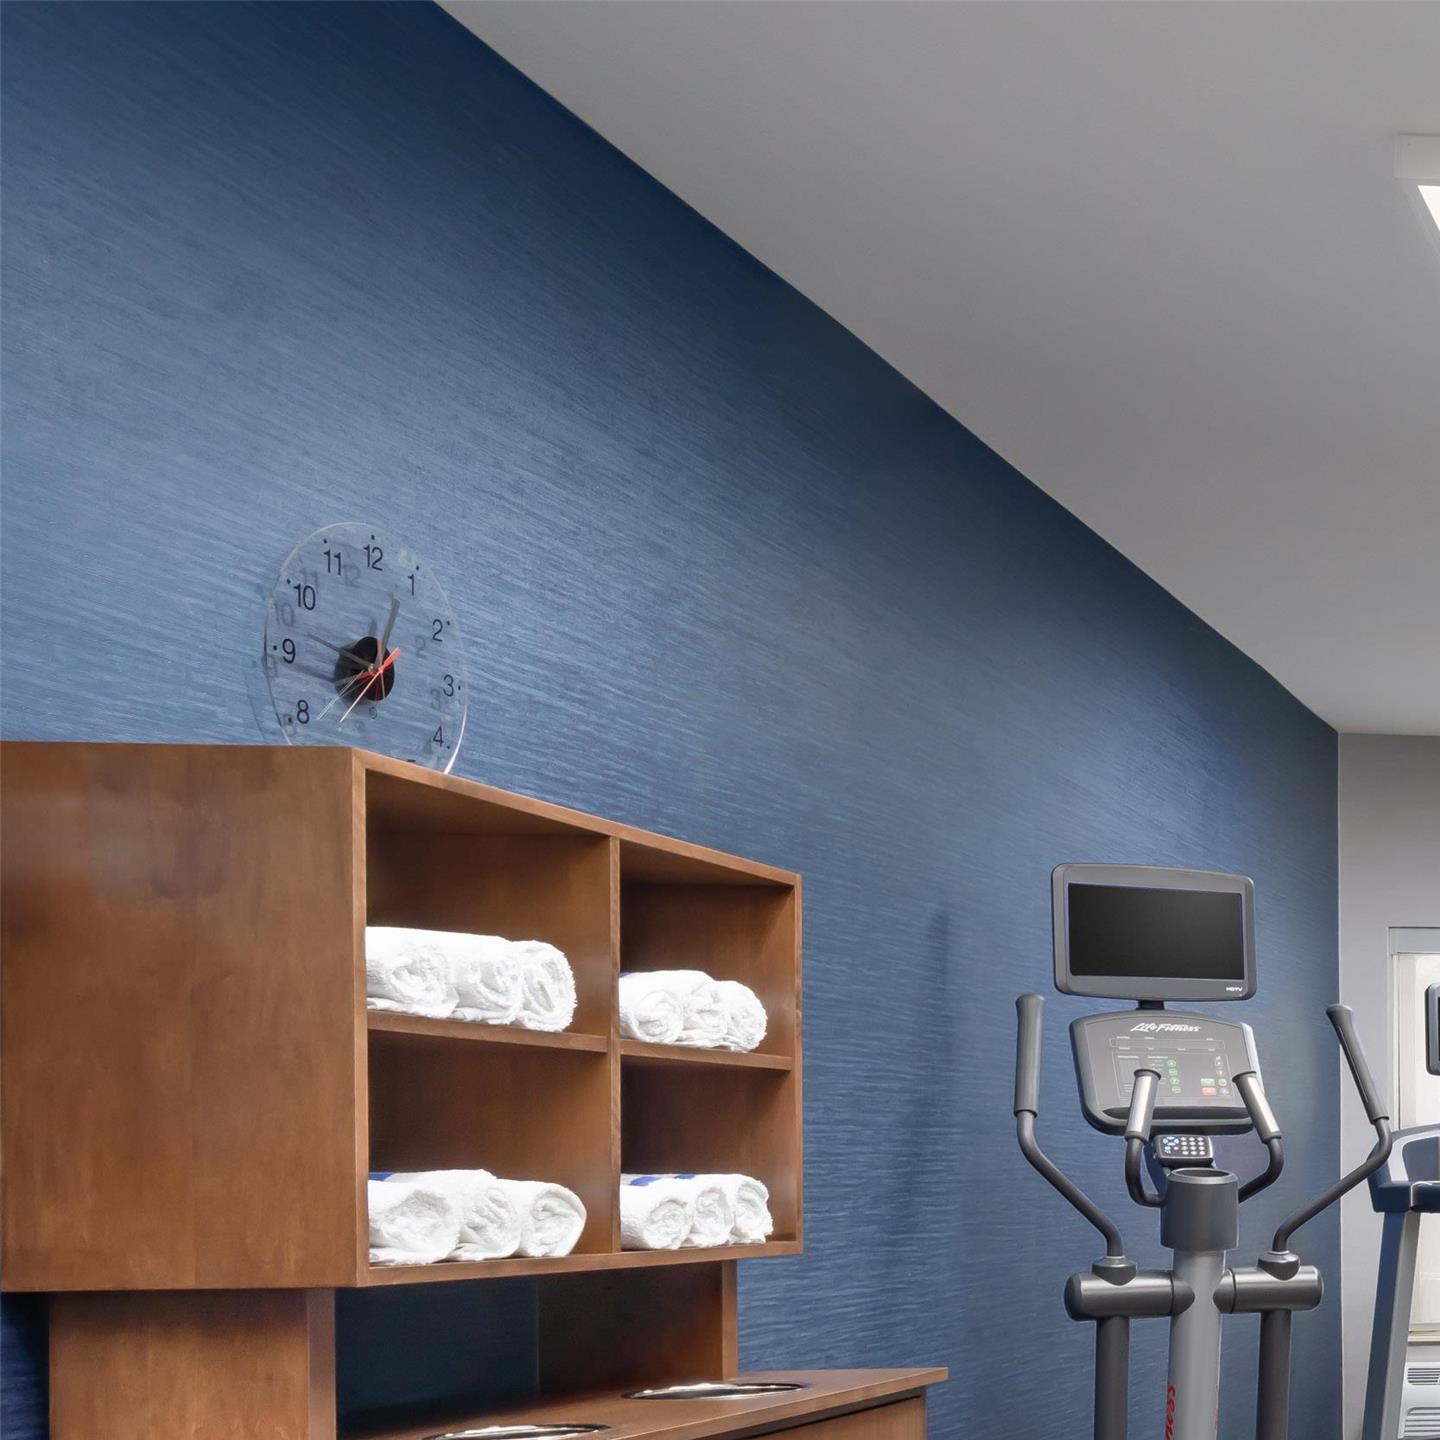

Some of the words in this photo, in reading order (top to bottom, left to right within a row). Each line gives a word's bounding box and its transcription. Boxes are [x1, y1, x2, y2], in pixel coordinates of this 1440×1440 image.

[323, 549, 342, 576] 11
[363, 544, 385, 571] 12
[293, 583, 316, 611] 10
[407, 573, 416, 596] 1
[432, 618, 443, 642] 2
[281, 638, 296, 664] 9
[443, 674, 455, 697] 3
[296, 699, 310, 725] 8
[432, 725, 444, 748] 4
